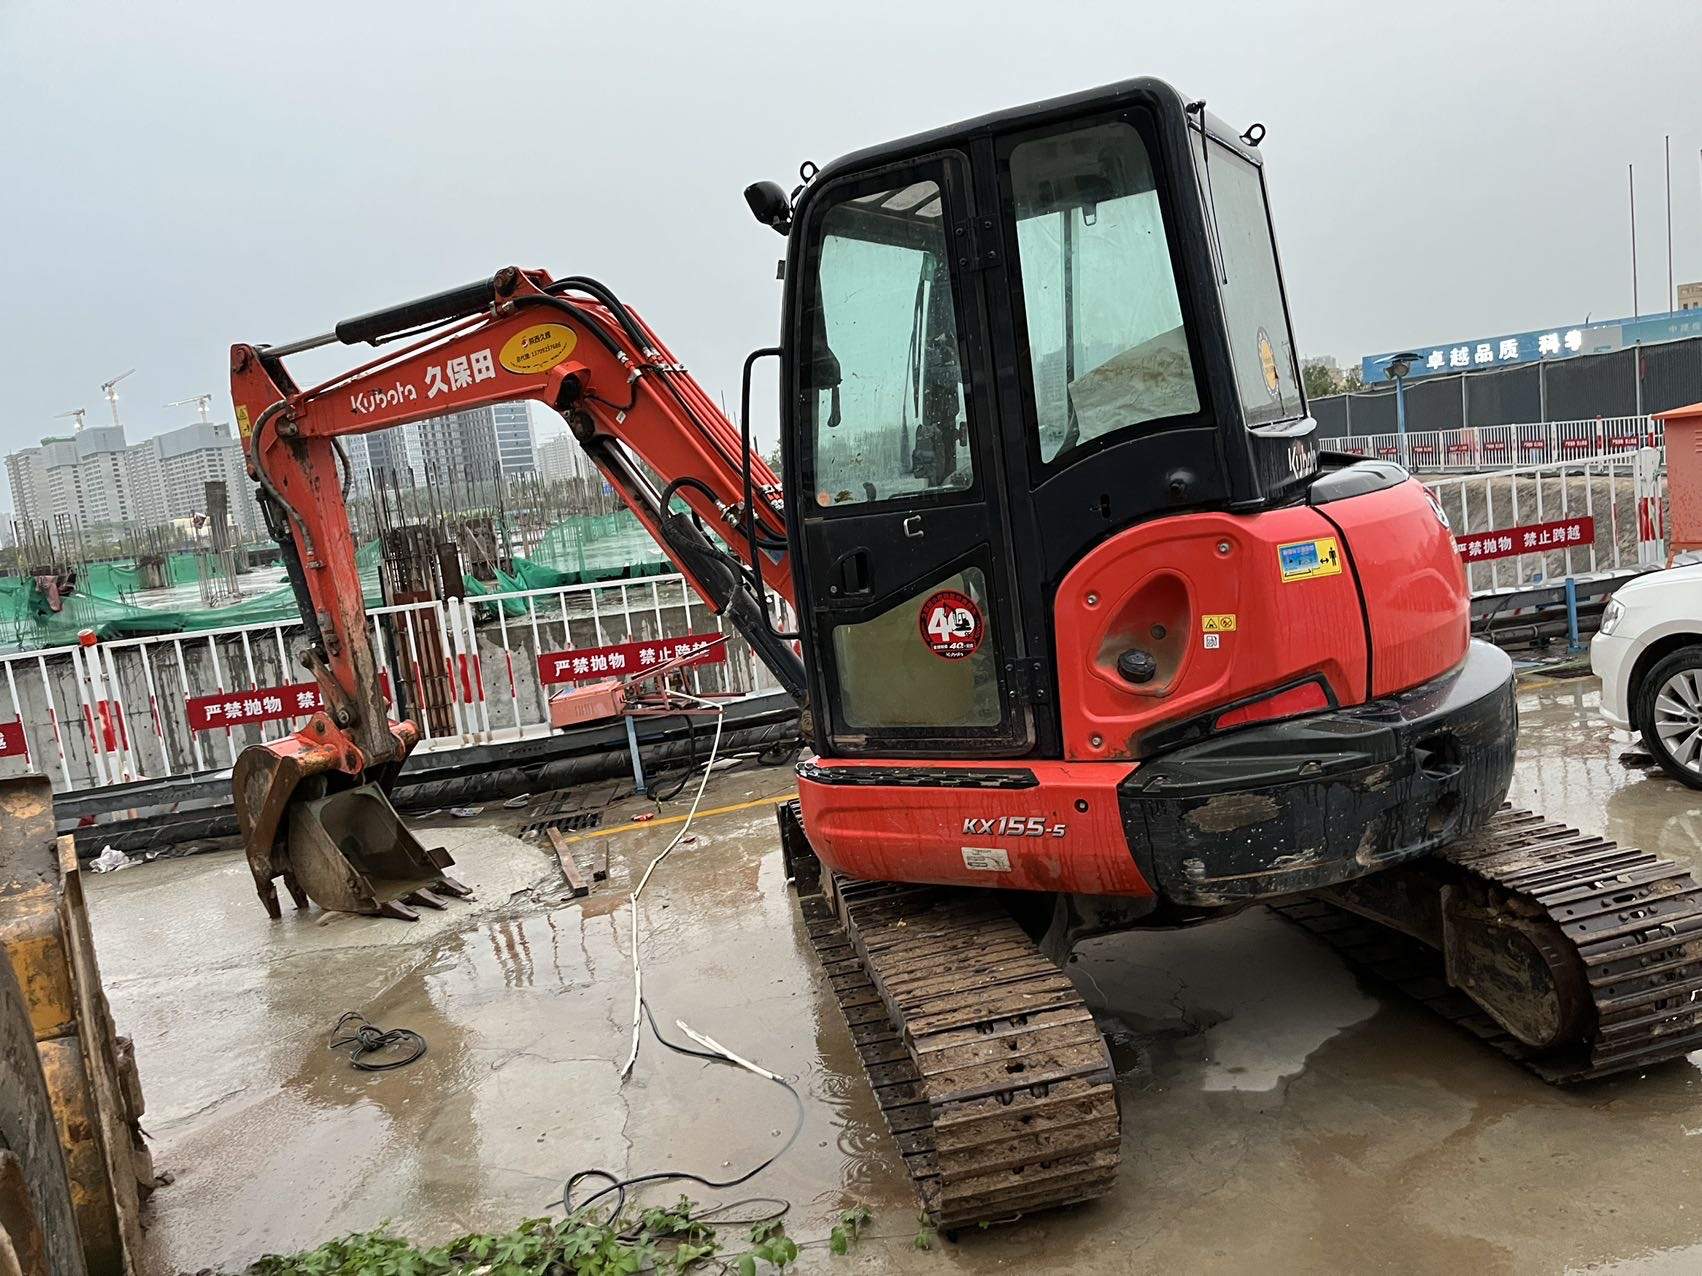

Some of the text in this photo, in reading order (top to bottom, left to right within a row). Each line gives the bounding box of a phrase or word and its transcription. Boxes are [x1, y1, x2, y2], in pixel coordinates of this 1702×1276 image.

[1426, 338, 1519, 370] 卓越品质
[351, 348, 496, 414] Kubota 久保田
[1523, 524, 1581, 548] 禁止跨越
[928, 607, 975, 642] 40
[553, 652, 626, 677] 严禁抛物
[203, 695, 282, 721] 严禁抛物
[962, 816, 1067, 838] KX155-5
